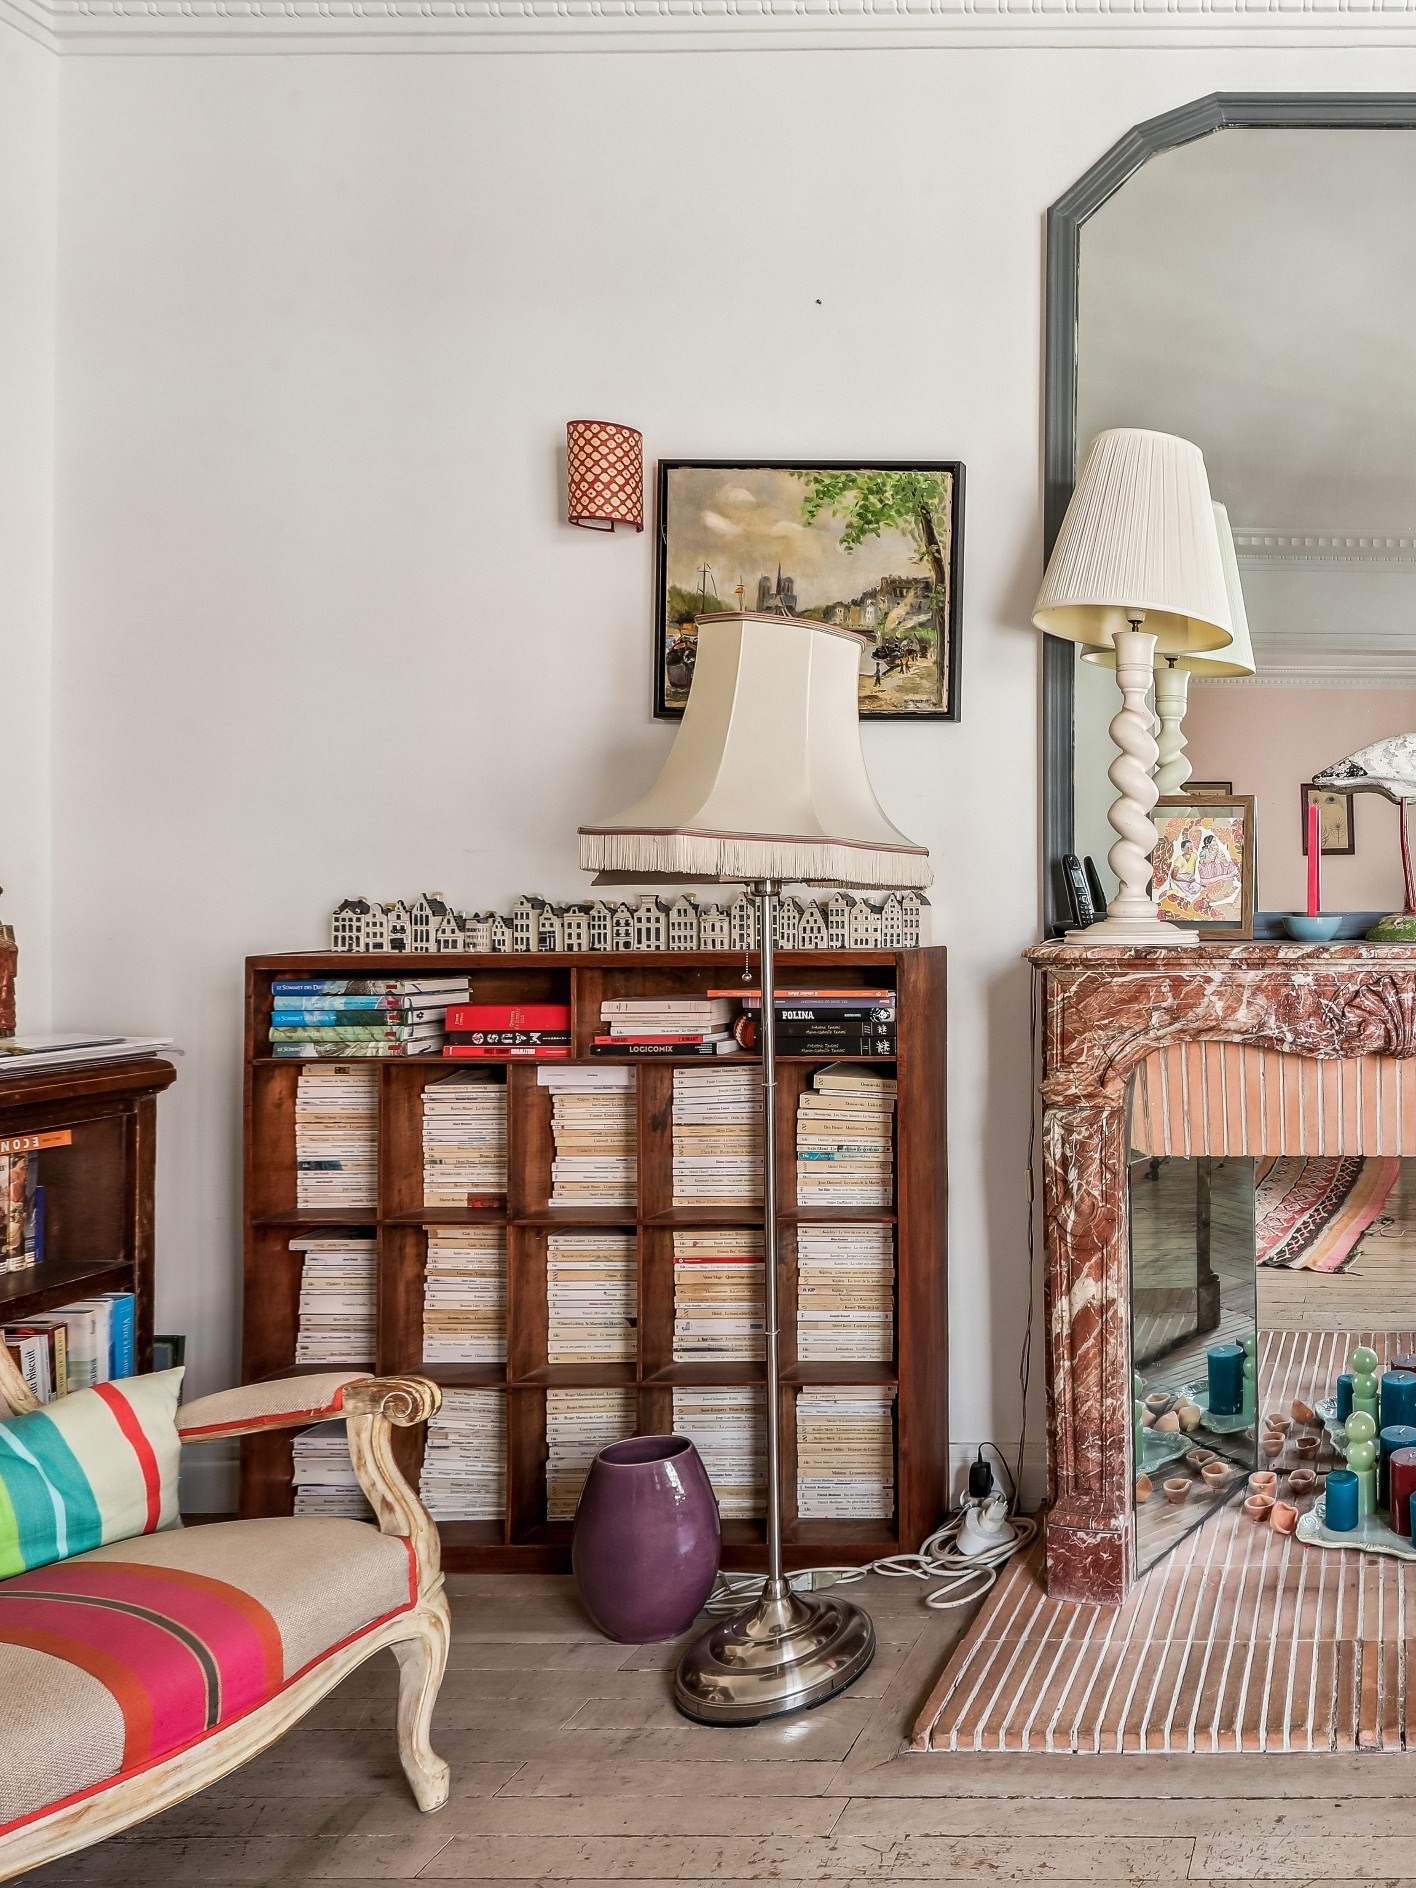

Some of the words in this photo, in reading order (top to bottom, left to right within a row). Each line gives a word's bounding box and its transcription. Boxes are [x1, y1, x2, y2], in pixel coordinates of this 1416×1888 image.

[782, 1011, 814, 1020] POLINA
[1, 1136, 39, 1152] ECON
[122, 1318, 131, 1338] Vivre
[26, 1349, 35, 1382] biscuit
